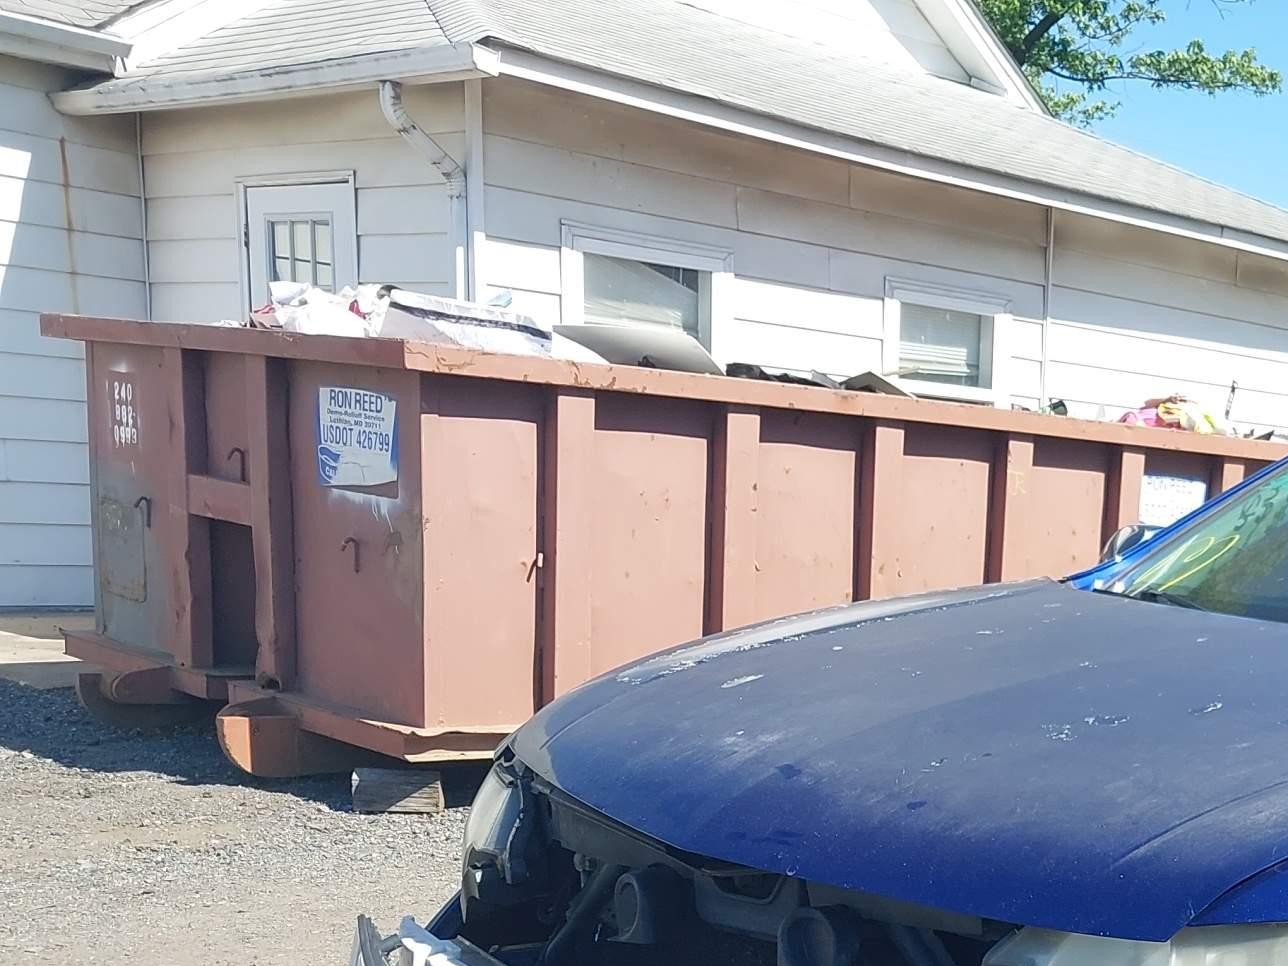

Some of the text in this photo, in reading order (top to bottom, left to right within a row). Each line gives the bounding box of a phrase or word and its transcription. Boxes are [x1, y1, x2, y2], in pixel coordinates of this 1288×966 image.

[329, 389, 383, 413] RON REED
[353, 419, 363, 427] MD
[363, 413, 385, 422] Service
[322, 423, 390, 453] USDOT 426799
